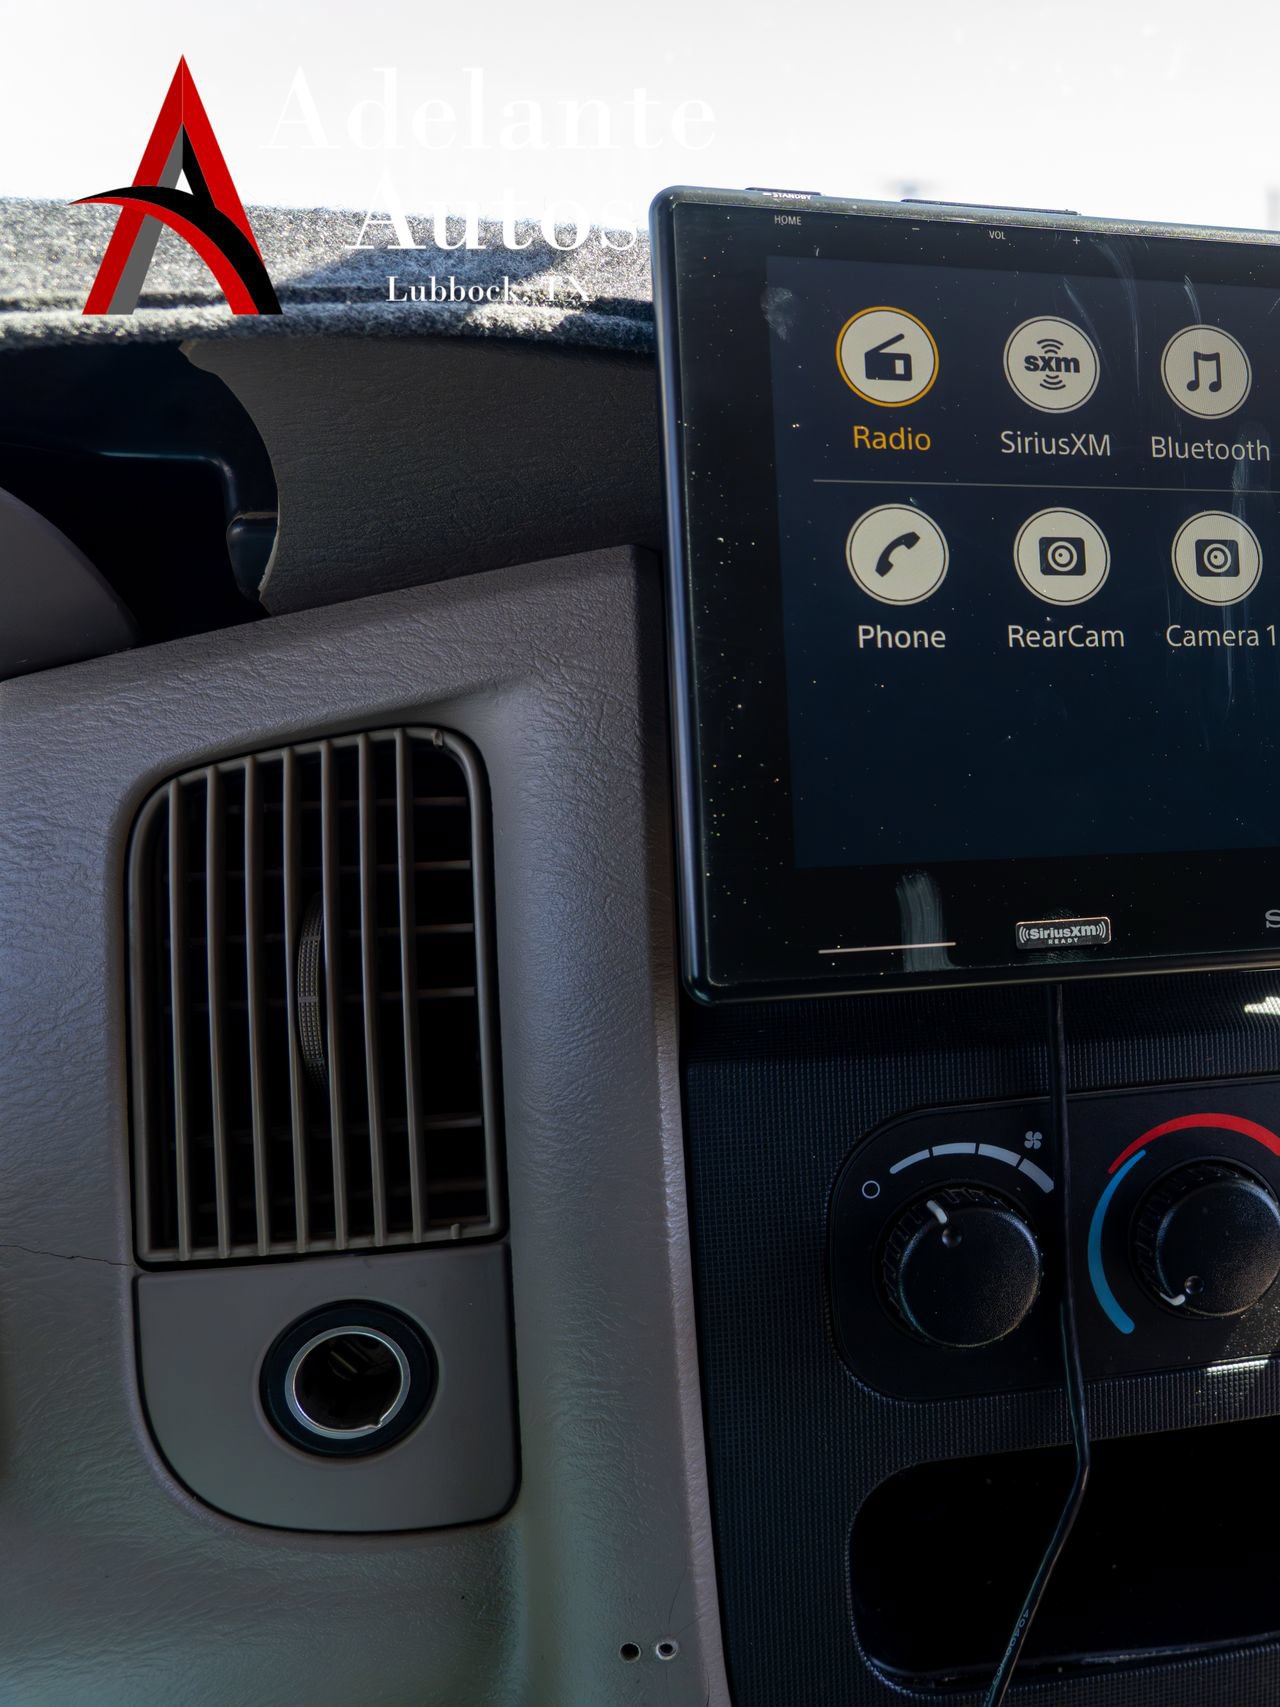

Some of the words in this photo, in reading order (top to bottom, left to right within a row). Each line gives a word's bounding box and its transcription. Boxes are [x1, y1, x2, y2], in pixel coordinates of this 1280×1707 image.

[772, 192, 812, 201] STANDBY
[774, 214, 803, 226] HOME
[988, 230, 1007, 240] VOL
[1024, 354, 1081, 374] sxm
[853, 426, 931, 451] Radio
[1001, 431, 1111, 456] SiriusXM
[1151, 436, 1271, 462] Bluetooth
[858, 624, 946, 648] Phone
[1008, 624, 1125, 648] RearCam
[1166, 625, 1259, 647] Camera
[1266, 625, 1276, 646] 1
[1048, 937, 1079, 945] READY
